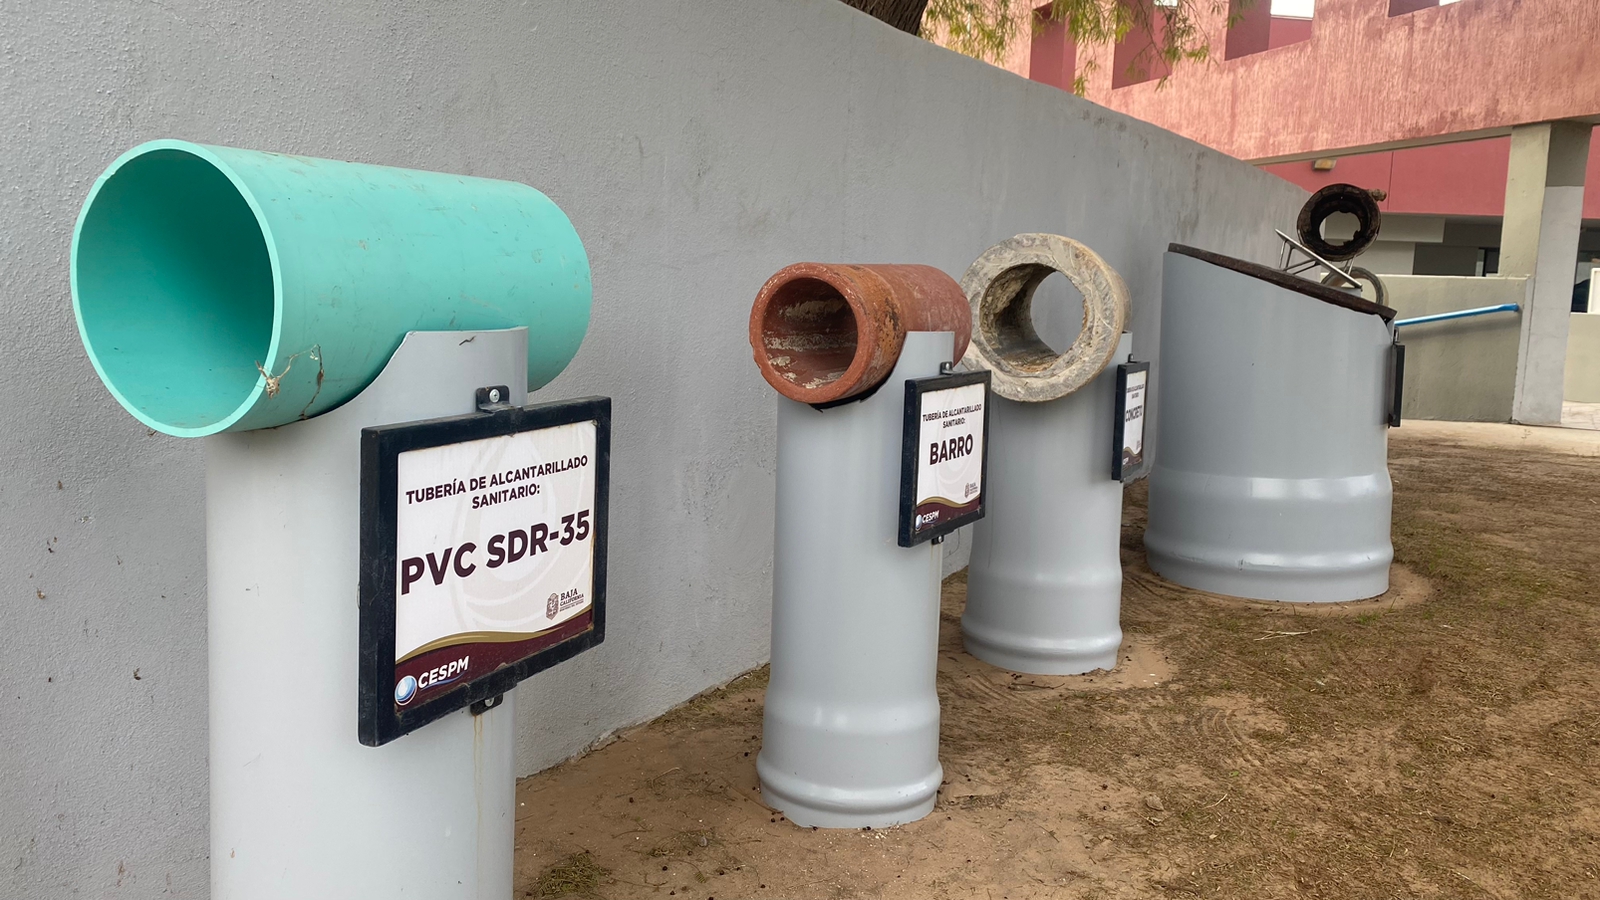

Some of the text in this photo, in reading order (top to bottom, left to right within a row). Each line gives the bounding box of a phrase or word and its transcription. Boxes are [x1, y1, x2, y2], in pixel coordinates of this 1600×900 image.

[922, 403, 982, 422] TUBERÍA DE ALCANTARILLADO
[942, 417, 966, 429] SANITARIO:
[929, 433, 974, 466] BARRO
[405, 455, 588, 504] TUBERÍA DE ALCANTARILLADO
[471, 483, 541, 510] SANITARIO:
[922, 509, 940, 524] CESPM
[401, 509, 590, 596] PVC SDR-35
[560, 588, 578, 601] BAJA
[418, 655, 469, 689] CESPM
